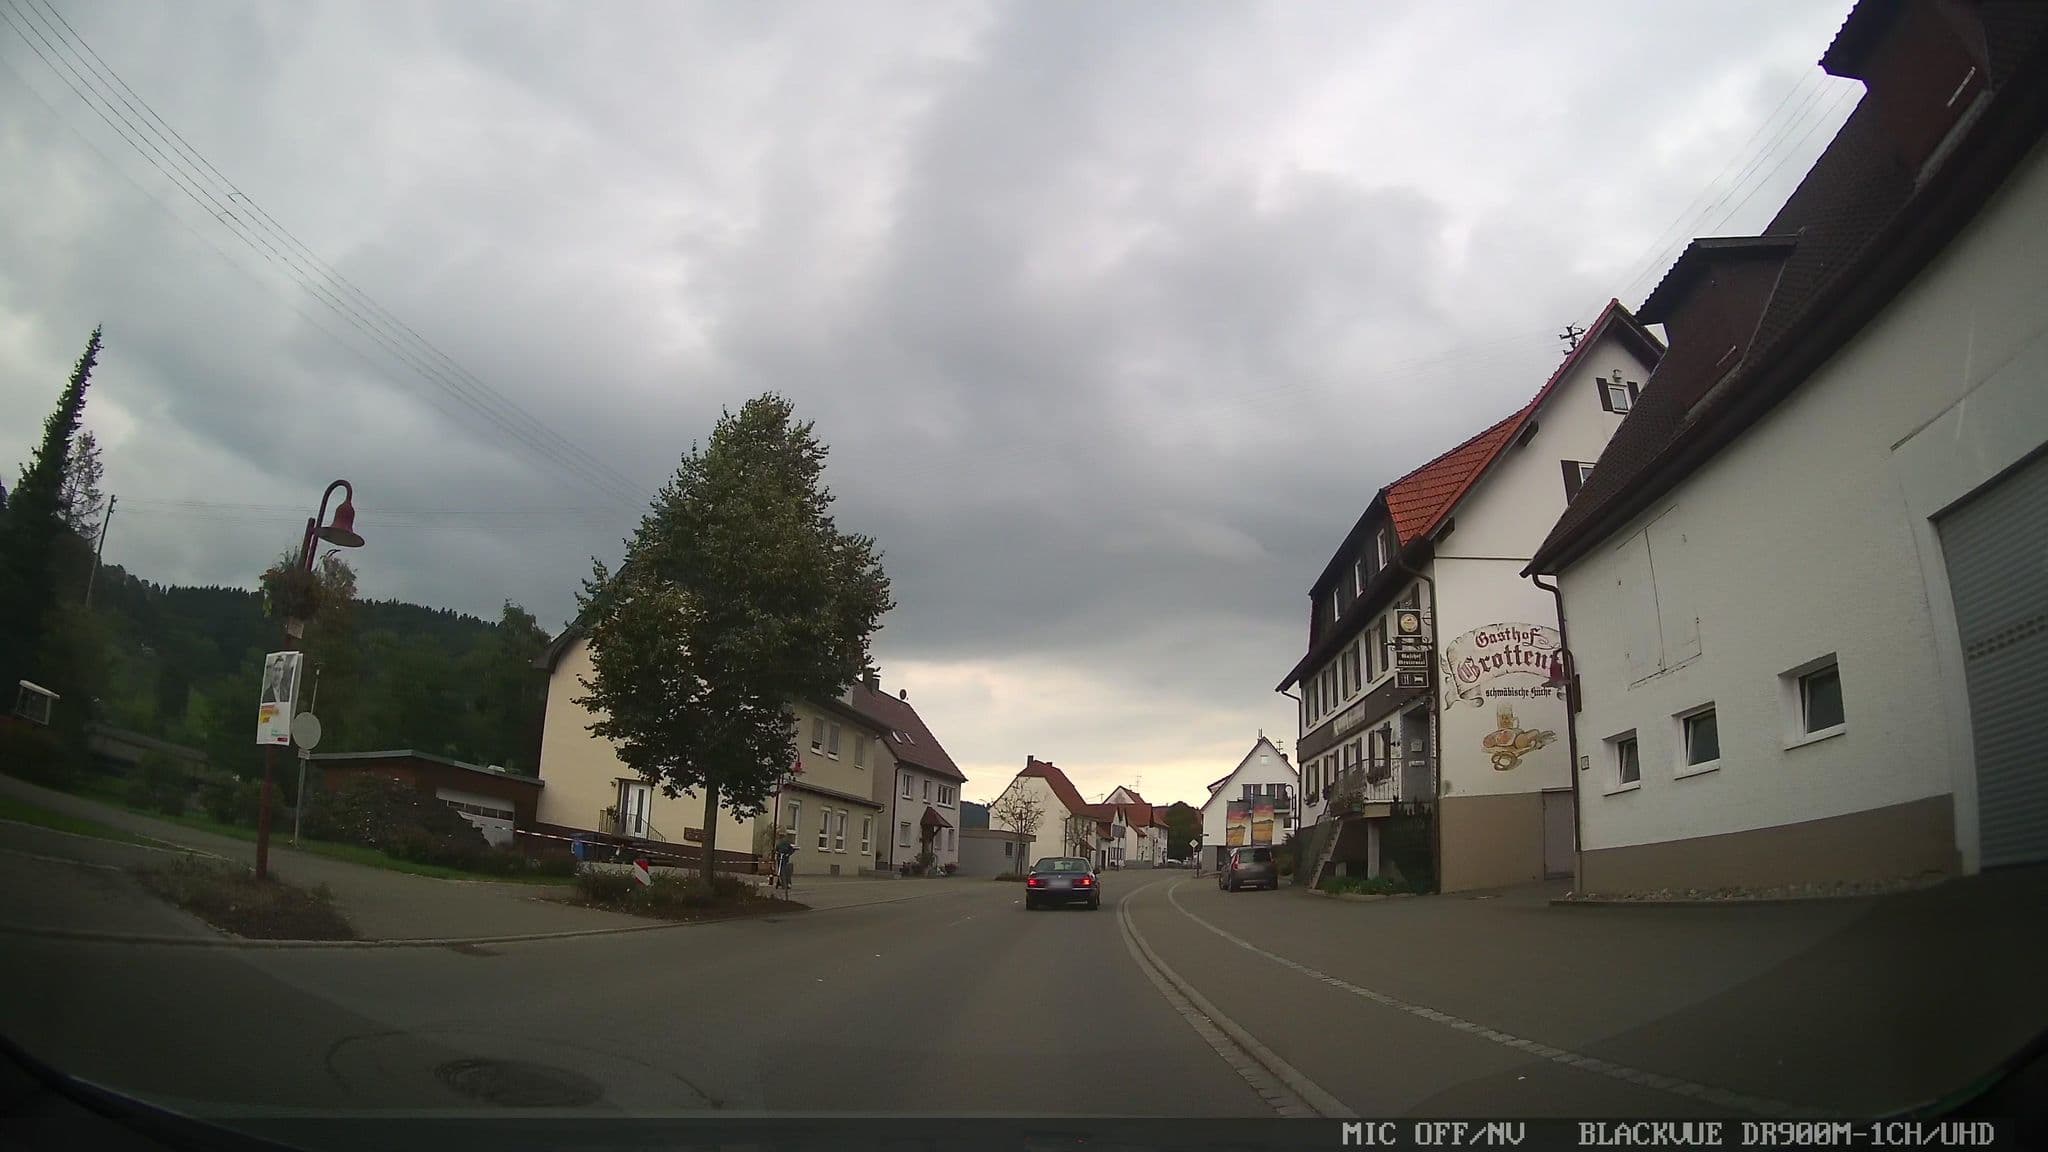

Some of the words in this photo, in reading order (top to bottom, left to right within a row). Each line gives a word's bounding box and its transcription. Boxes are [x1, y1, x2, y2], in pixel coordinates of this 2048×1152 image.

[1475, 627, 1541, 648] Gasthof
[1457, 645, 1551, 683] Grotten
[1485, 687, 1529, 698] schwäbische
